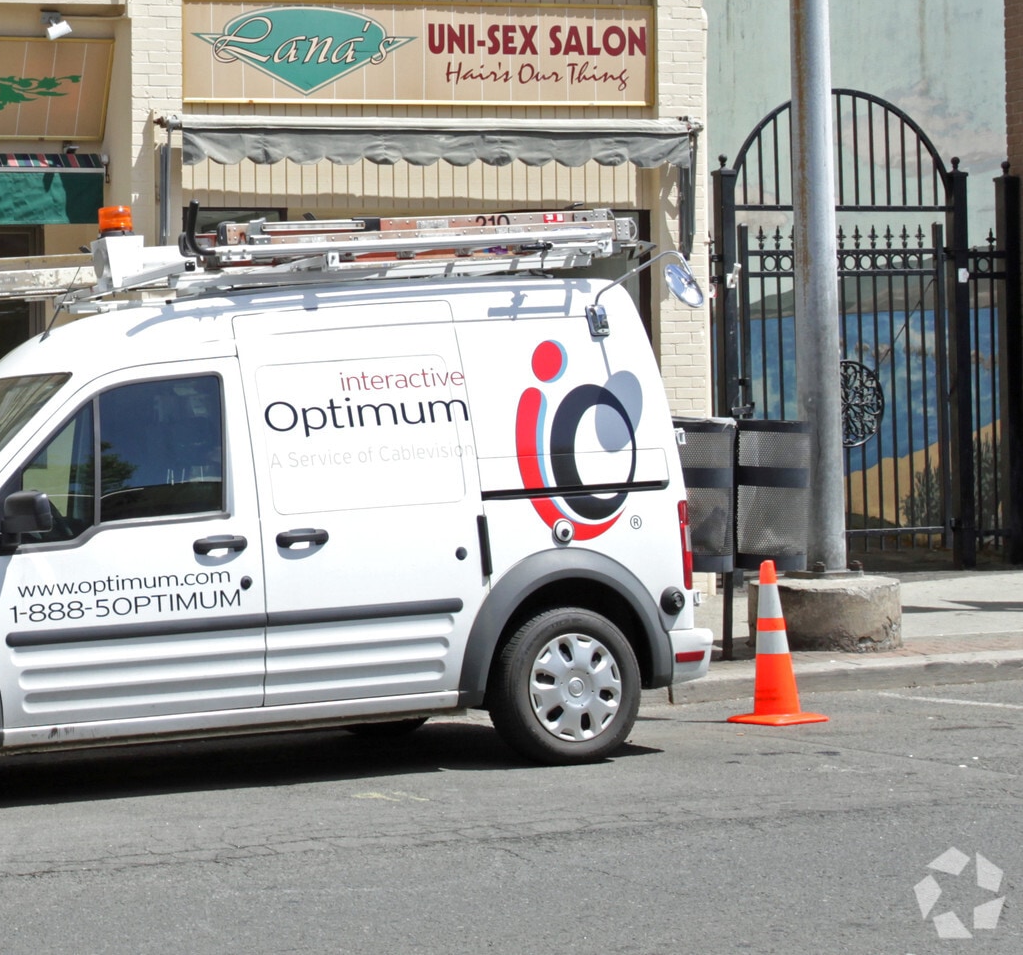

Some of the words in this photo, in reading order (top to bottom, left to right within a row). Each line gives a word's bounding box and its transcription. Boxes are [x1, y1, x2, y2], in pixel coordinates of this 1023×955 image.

[212, 16, 396, 65] Lana's
[428, 23, 538, 55] UNI-SEX
[549, 25, 646, 56] SALON
[445, 62, 512, 85] Hair's
[518, 63, 563, 85] Our
[567, 61, 629, 91] Thing
[340, 368, 464, 391] interactive
[264, 397, 469, 437] Optimum
[271, 454, 282, 468] A
[289, 449, 351, 468] Service
[358, 448, 374, 464] of
[379, 442, 475, 461] Cablevision
[17, 570, 231, 598] www.optimum.com
[9, 589, 242, 623] 1-888-5OPTIMUM
